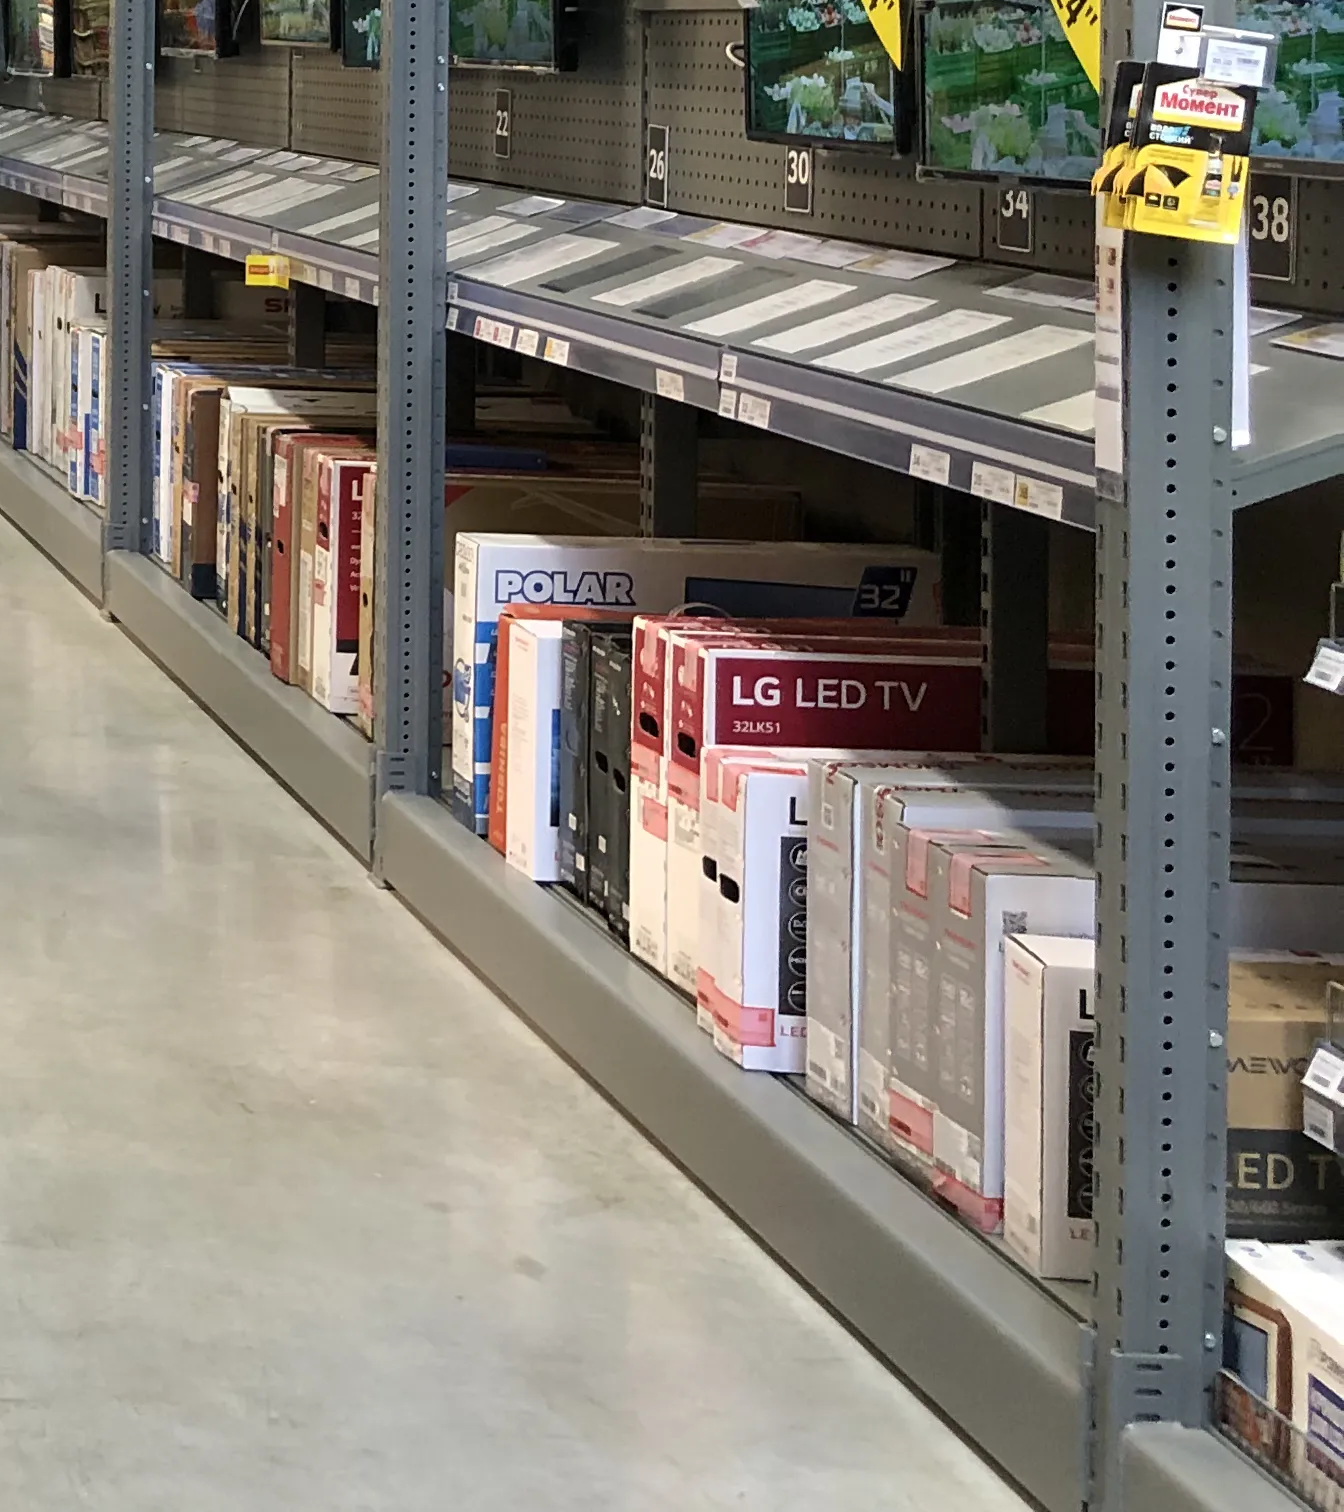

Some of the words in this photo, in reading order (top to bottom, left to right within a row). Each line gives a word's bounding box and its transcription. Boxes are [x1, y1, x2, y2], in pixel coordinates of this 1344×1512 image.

[1160, 91, 1240, 119] Момент
[1182, 85, 1219, 100] Супер
[496, 109, 509, 137] 22
[649, 148, 664, 181] 26
[787, 149, 809, 185] 30
[1001, 189, 1029, 219] 34
[1251, 194, 1289, 243] 38
[494, 569, 637, 606] POLAR
[732, 675, 781, 707] LG
[795, 677, 867, 710] LED
[874, 680, 928, 712] TV
[732, 720, 781, 735] 32LK51
[495, 722, 508, 814] TOSHIBA
[1226, 1152, 1295, 1190] ED
